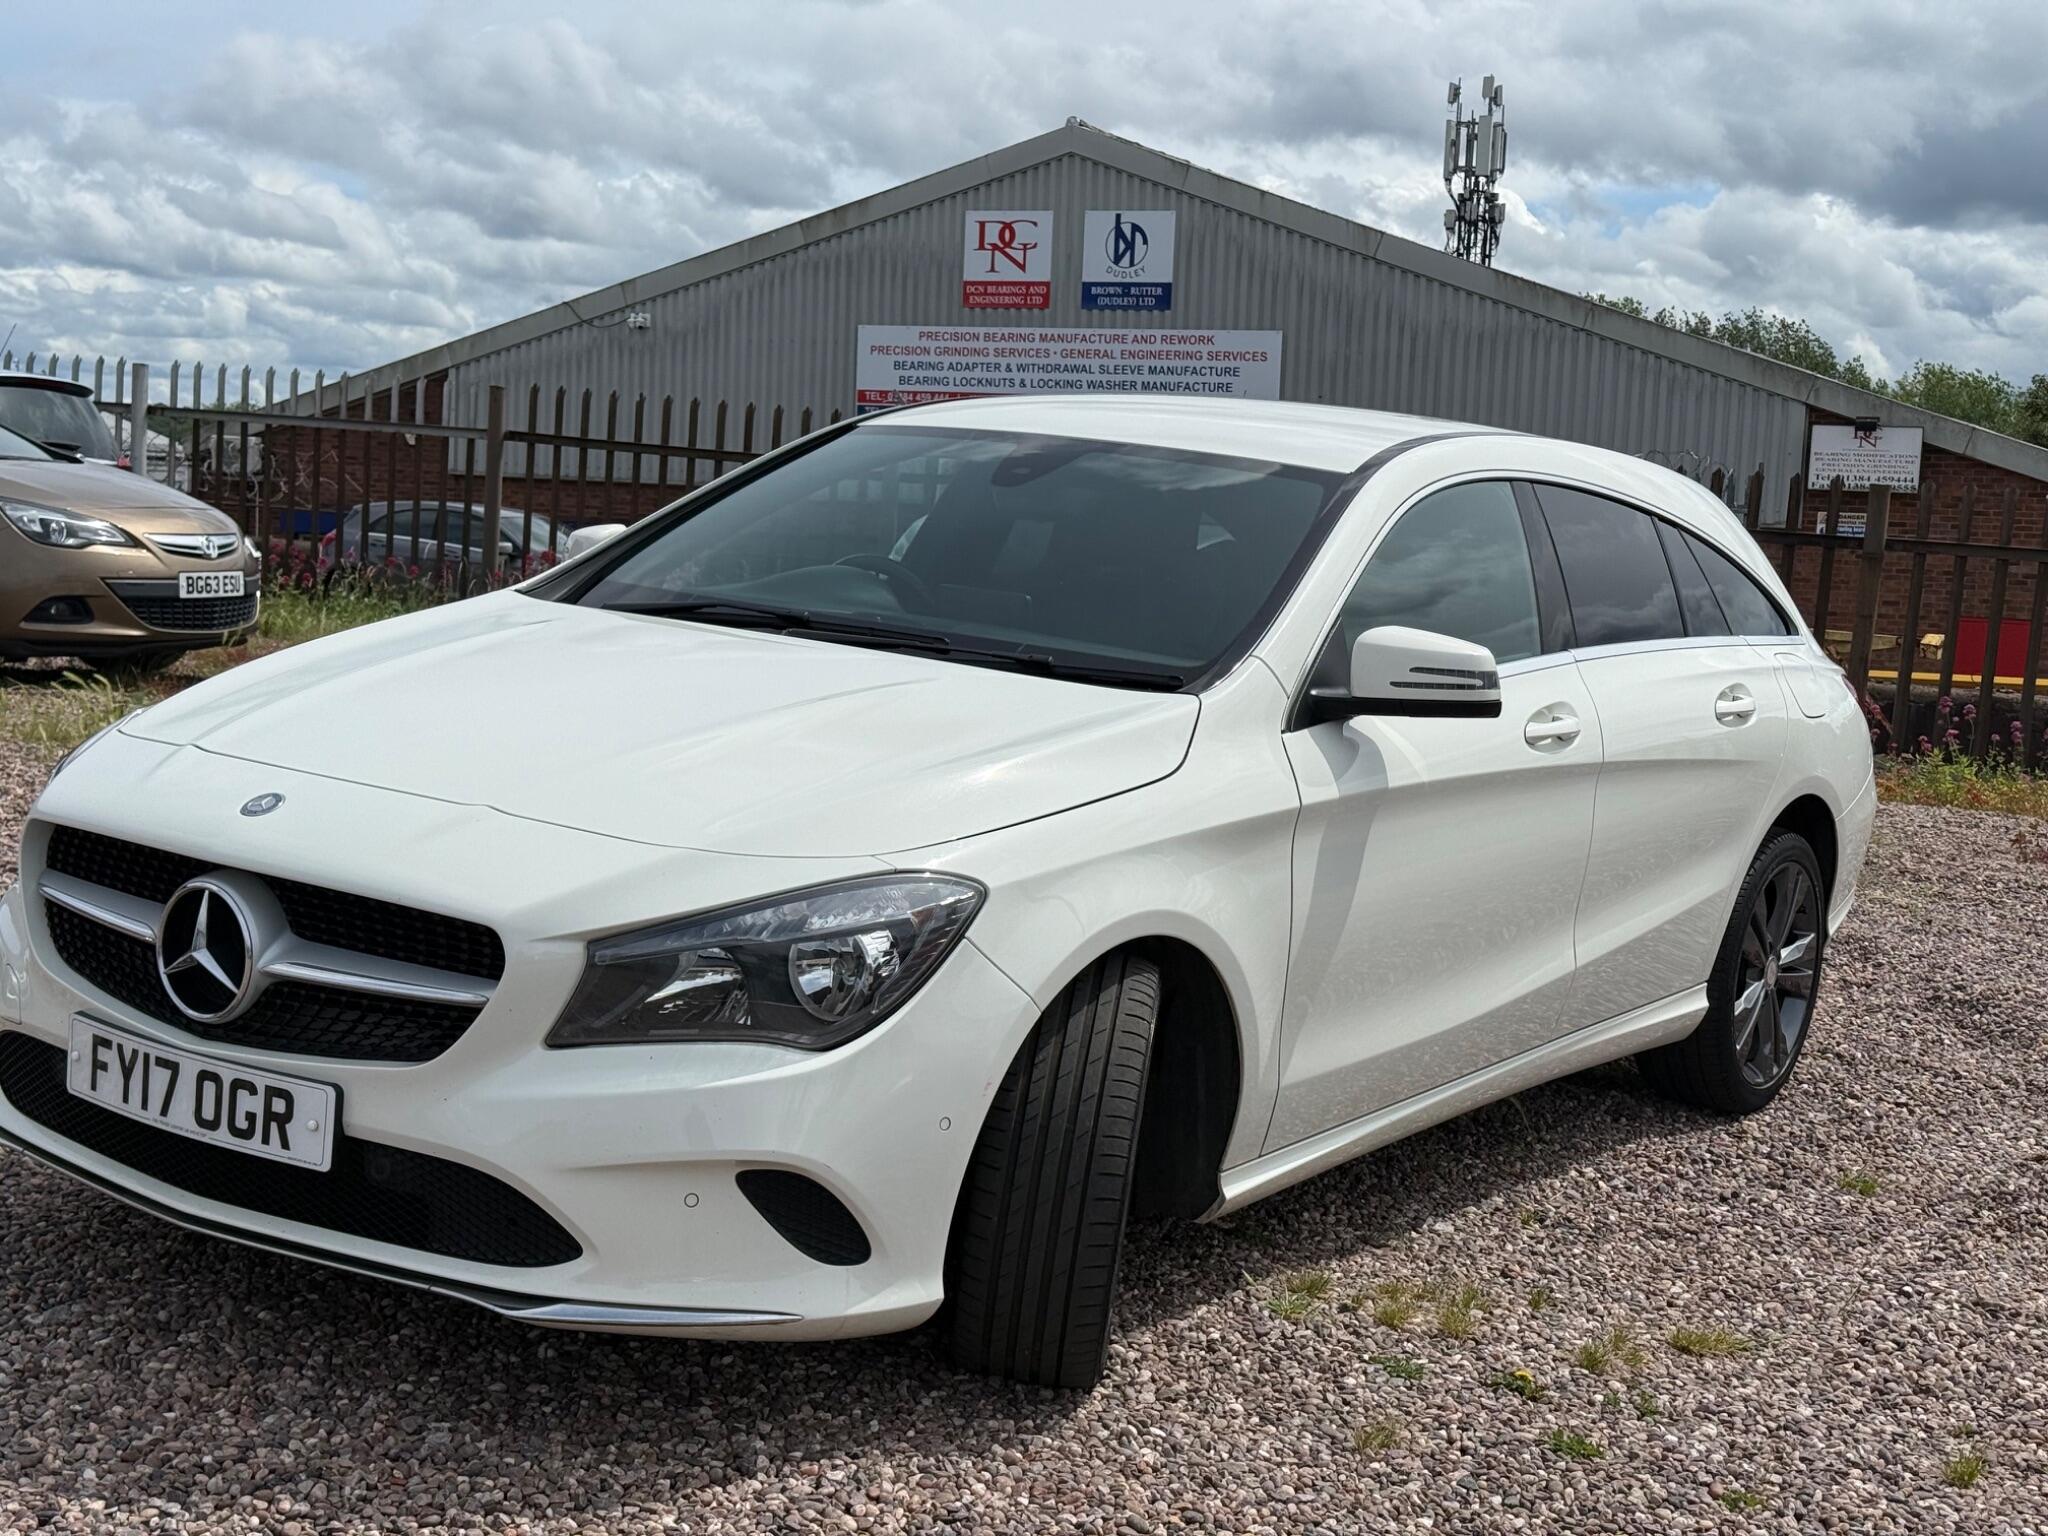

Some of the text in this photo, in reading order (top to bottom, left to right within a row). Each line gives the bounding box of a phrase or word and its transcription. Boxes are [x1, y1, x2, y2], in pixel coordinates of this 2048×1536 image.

[1105, 265, 1146, 280] DUDLEY
[966, 285, 1047, 294] DCN BEARINGS AND
[1091, 286, 1122, 295] BROWN
[1130, 287, 1163, 296] RUTTER
[969, 296, 1043, 305] ENGINEERING LTD
[1097, 297, 1156, 306] (DUDLEY) LTD
[919, 331, 1215, 346] PRECISION BEARING MANUFACTURE AND REWORK
[870, 345, 1268, 362] PRECISION GRINDING SERVICES GENERAL ENGINEERING SERVICES
[893, 361, 1240, 377] BEARING ADAPTER & WITHDRAWAL SLEEVE MANUFACTURE
[899, 376, 1233, 393] BEARING LOCKNUTS & LOCKING WASHER MANUFACTURE
[186, 575, 241, 594] BG63 ESU
[90, 1033, 295, 1151] FY17 OGR
